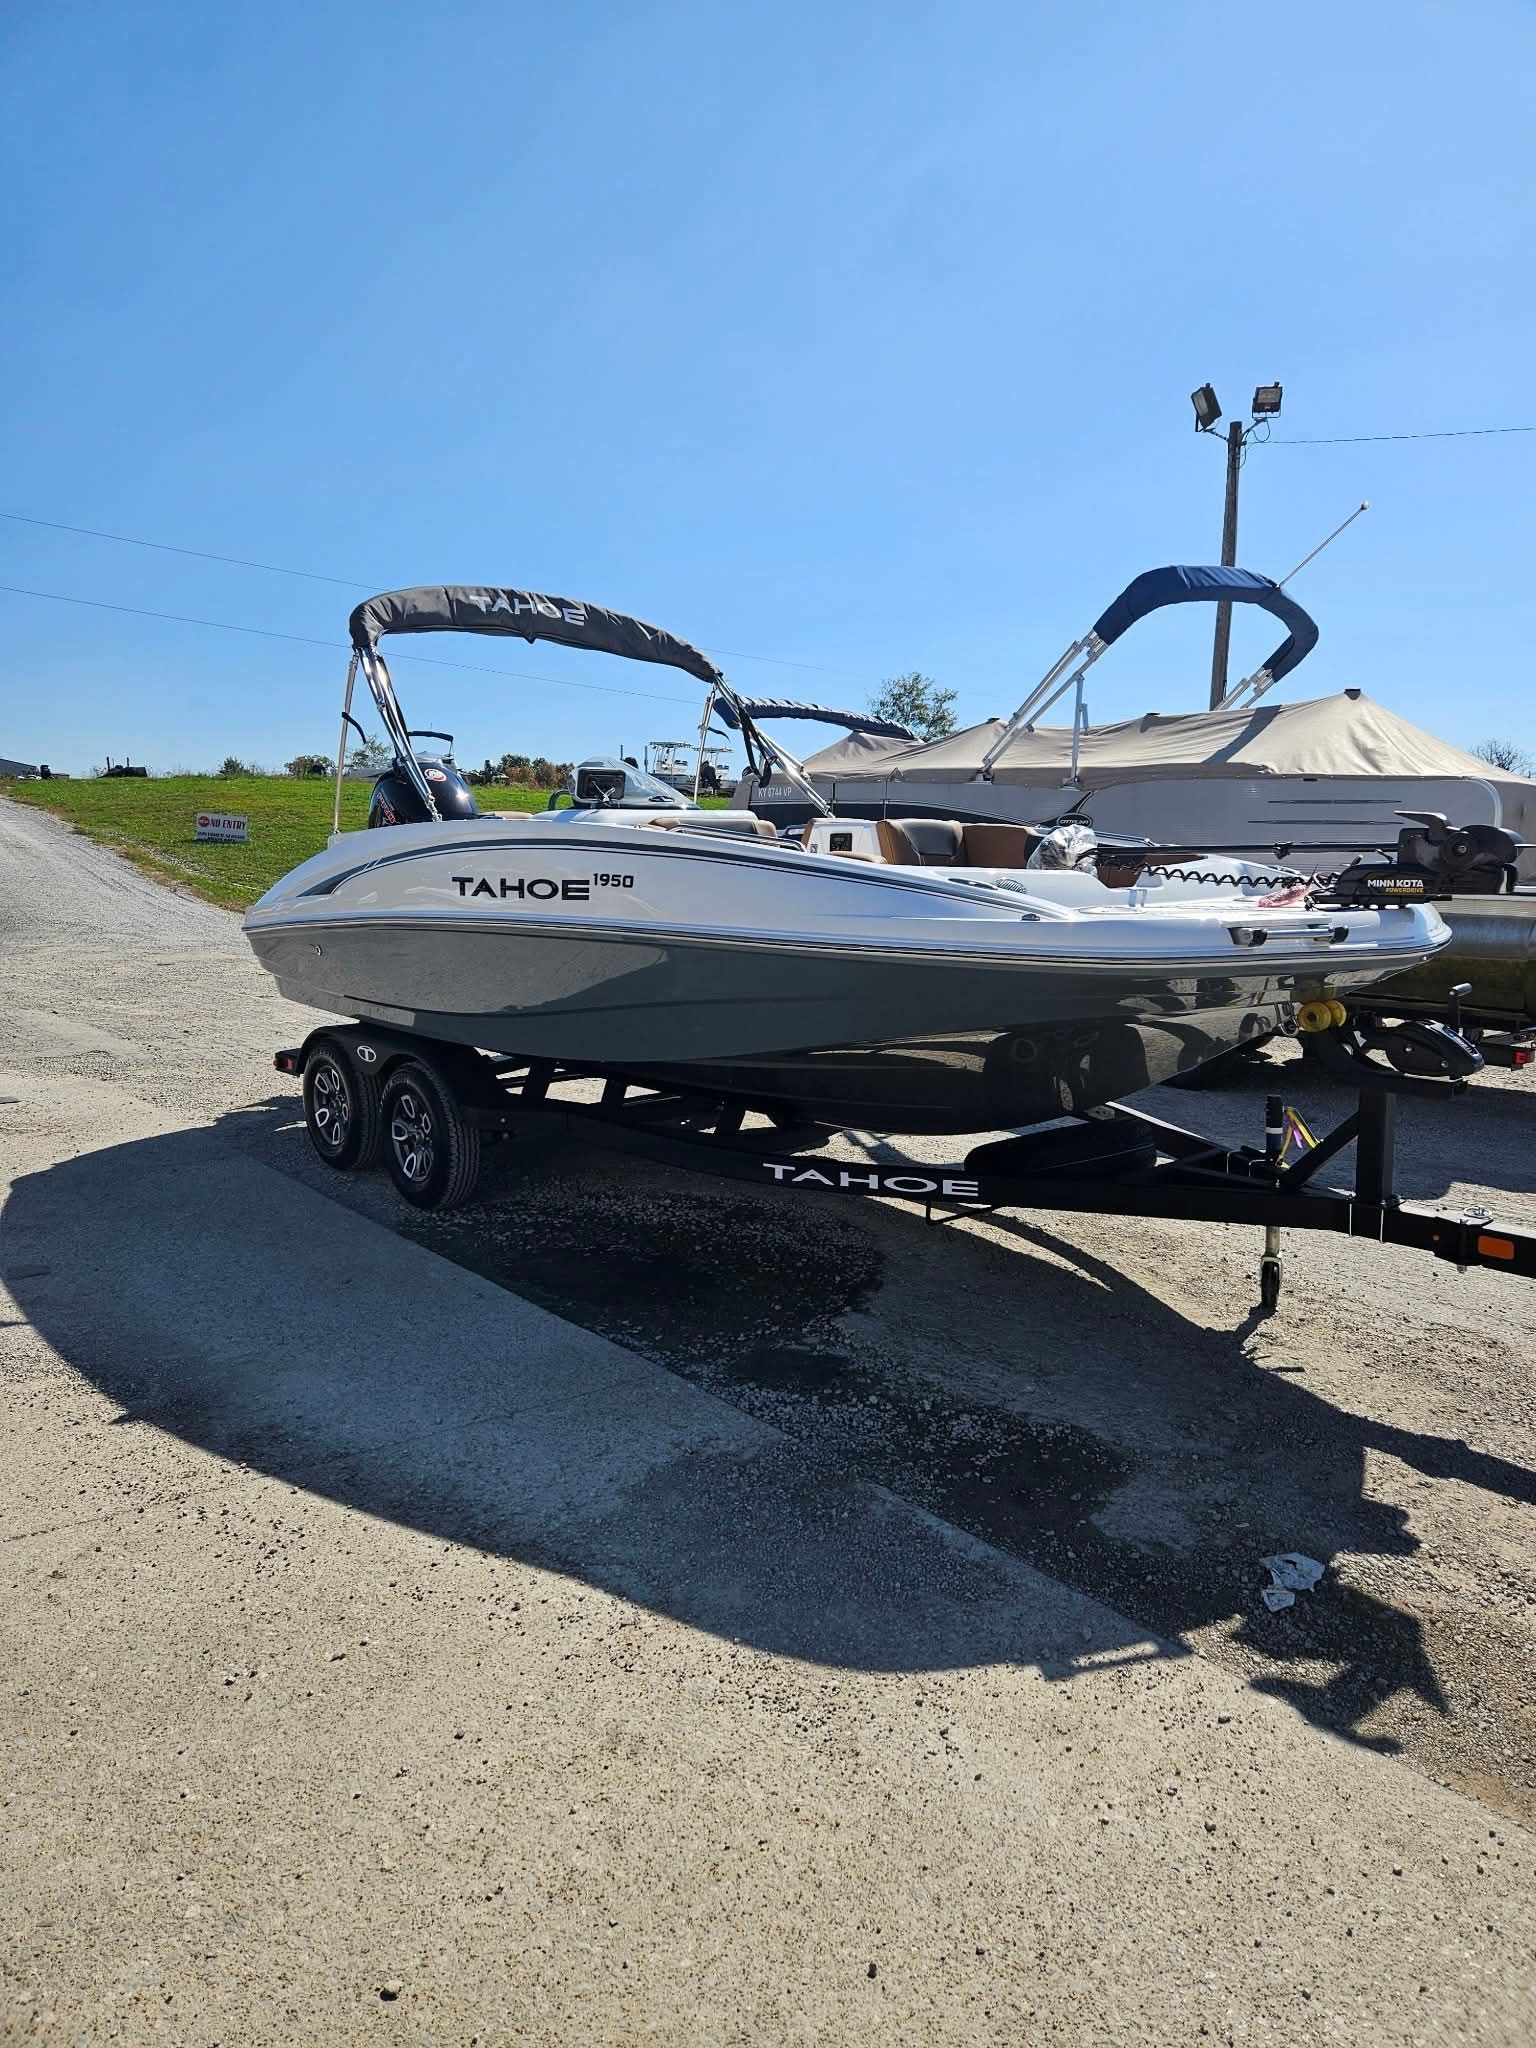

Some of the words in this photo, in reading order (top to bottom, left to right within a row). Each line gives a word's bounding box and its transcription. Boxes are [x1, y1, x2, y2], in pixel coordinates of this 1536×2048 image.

[469, 595, 585, 626] TAHOE
[758, 787, 767, 798] KY
[768, 787, 782, 797] 0744
[783, 786, 792, 797] VP
[210, 818, 220, 828] NO
[222, 819, 247, 830] ENTRY
[451, 876, 590, 901] TAHOE
[593, 872, 634, 889] 1950
[1367, 879, 1395, 888] MINN
[1396, 879, 1424, 888] KOTA
[762, 1162, 979, 1197] TAHOE
